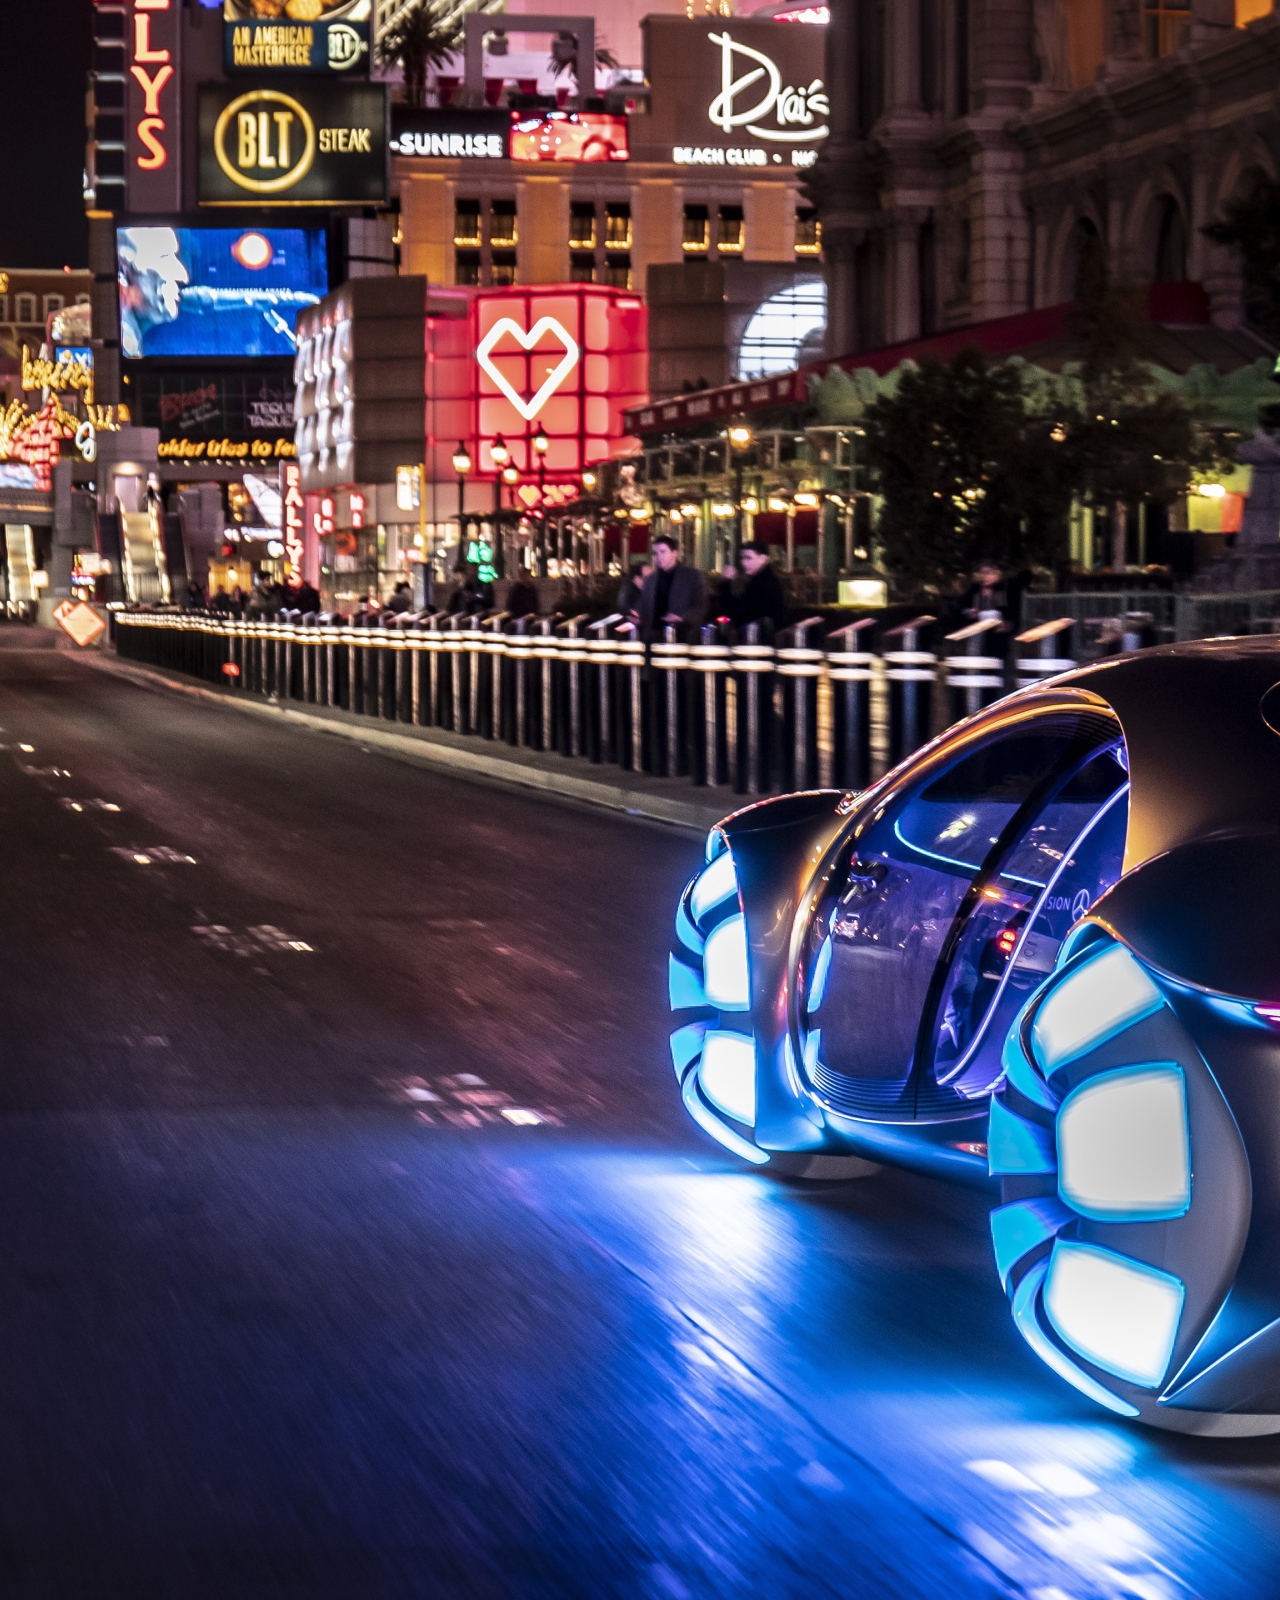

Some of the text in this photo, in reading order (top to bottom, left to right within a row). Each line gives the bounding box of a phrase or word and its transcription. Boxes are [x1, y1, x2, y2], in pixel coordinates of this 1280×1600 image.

[233, 26, 313, 46] AN AMERICAN
[233, 45, 312, 66] MASTERPIECE
[129, 0, 174, 170] LYS
[238, 111, 371, 168] BLT STEAK
[673, 147, 725, 165] BEACH
[726, 148, 767, 166] CLUB
[251, 439, 273, 457] to
